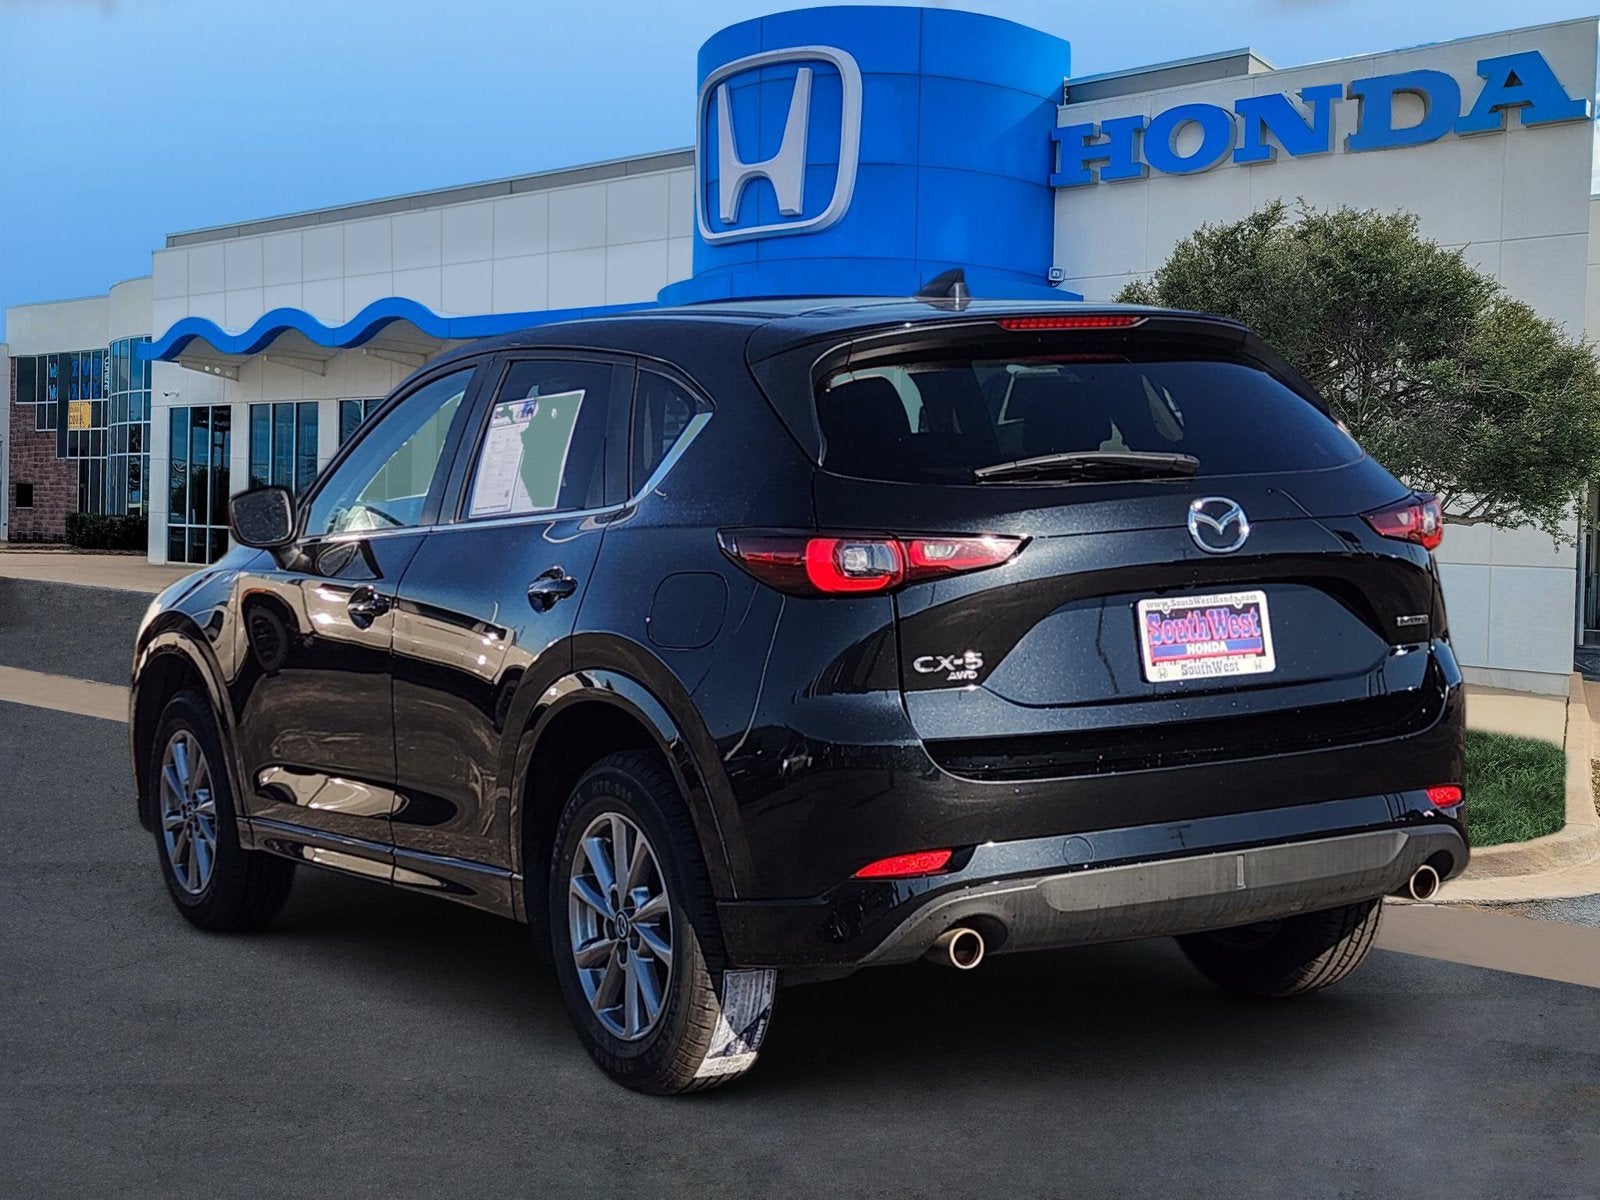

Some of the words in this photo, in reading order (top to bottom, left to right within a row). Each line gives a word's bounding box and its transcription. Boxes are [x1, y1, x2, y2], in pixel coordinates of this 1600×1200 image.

[1050, 50, 1591, 188] HONDA
[1146, 606, 1261, 645] SouthWest
[1186, 640, 1229, 655] HONDA
[912, 651, 984, 673] CX-5
[1181, 661, 1241, 677] SouthWest
[946, 669, 979, 681] AWD
